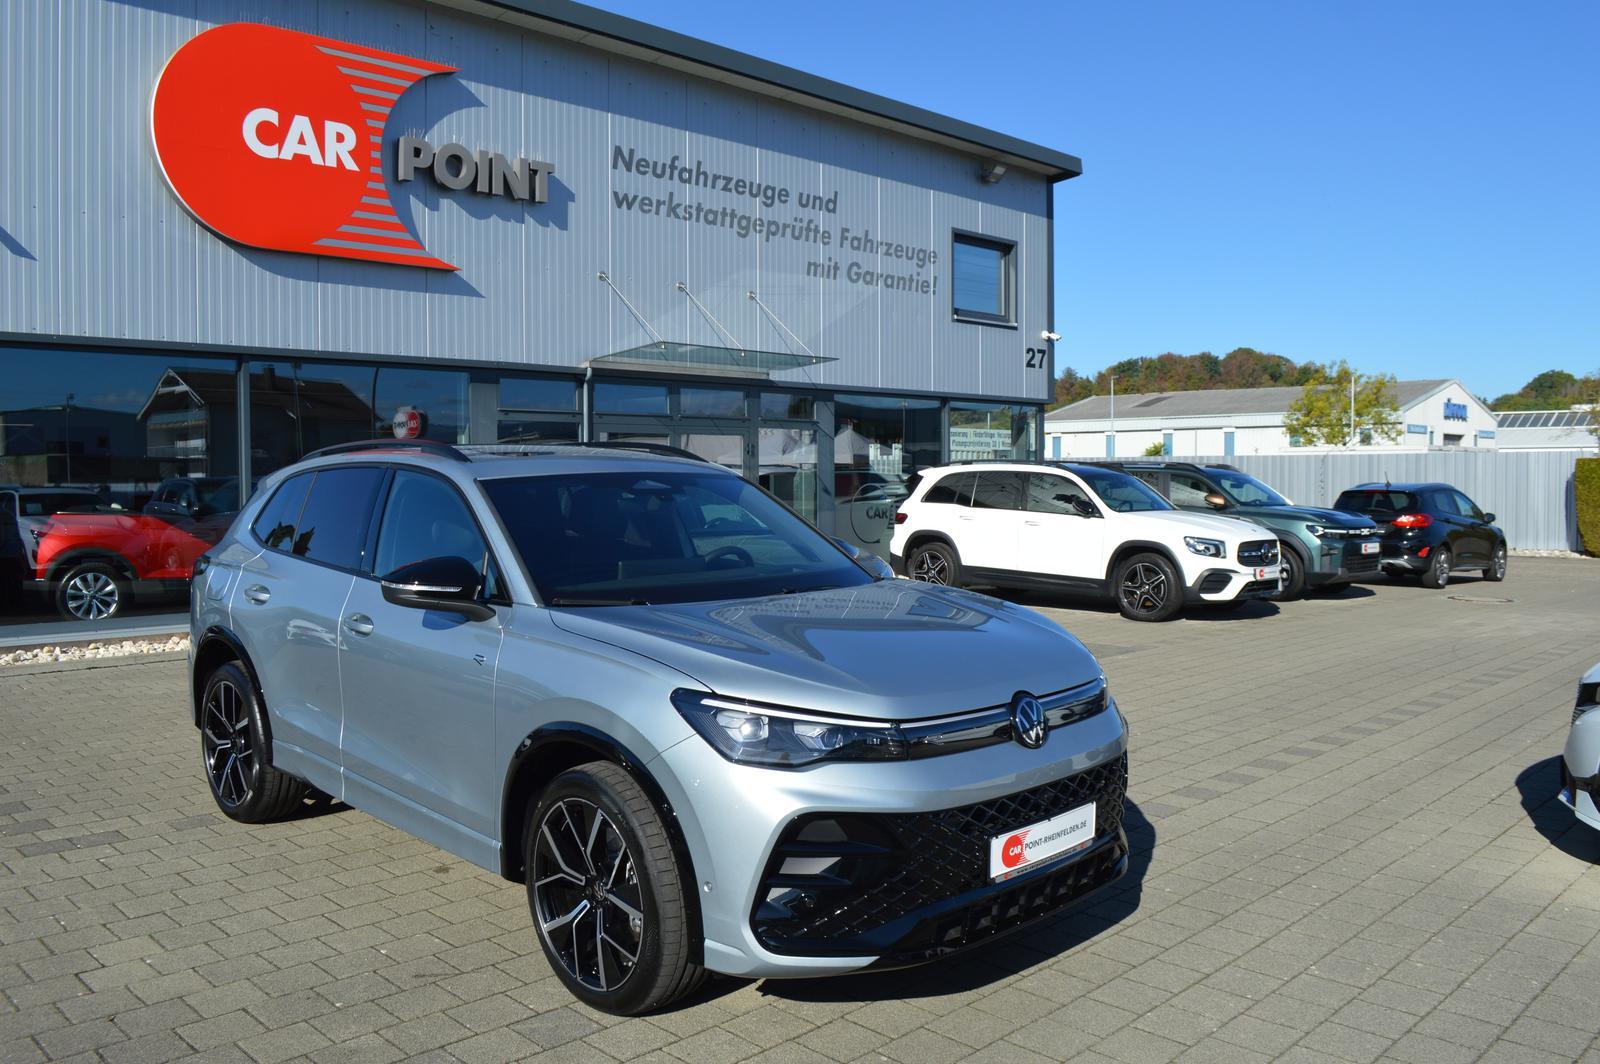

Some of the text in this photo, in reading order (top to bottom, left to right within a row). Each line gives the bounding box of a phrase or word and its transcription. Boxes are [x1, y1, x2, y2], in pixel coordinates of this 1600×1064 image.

[242, 107, 360, 172] CAR
[397, 135, 555, 203] POINT
[612, 145, 838, 214] Neufahrzeuge und
[612, 191, 938, 269] werkstattgeprüfte Fahrzeuge
[806, 257, 938, 296] mit Garantie!
[1026, 347, 1047, 369] 27
[866, 506, 888, 520] CAR
[1009, 844, 1022, 856] CAR
[1024, 819, 1087, 851] POINT-RHEINFELDEN.DE
